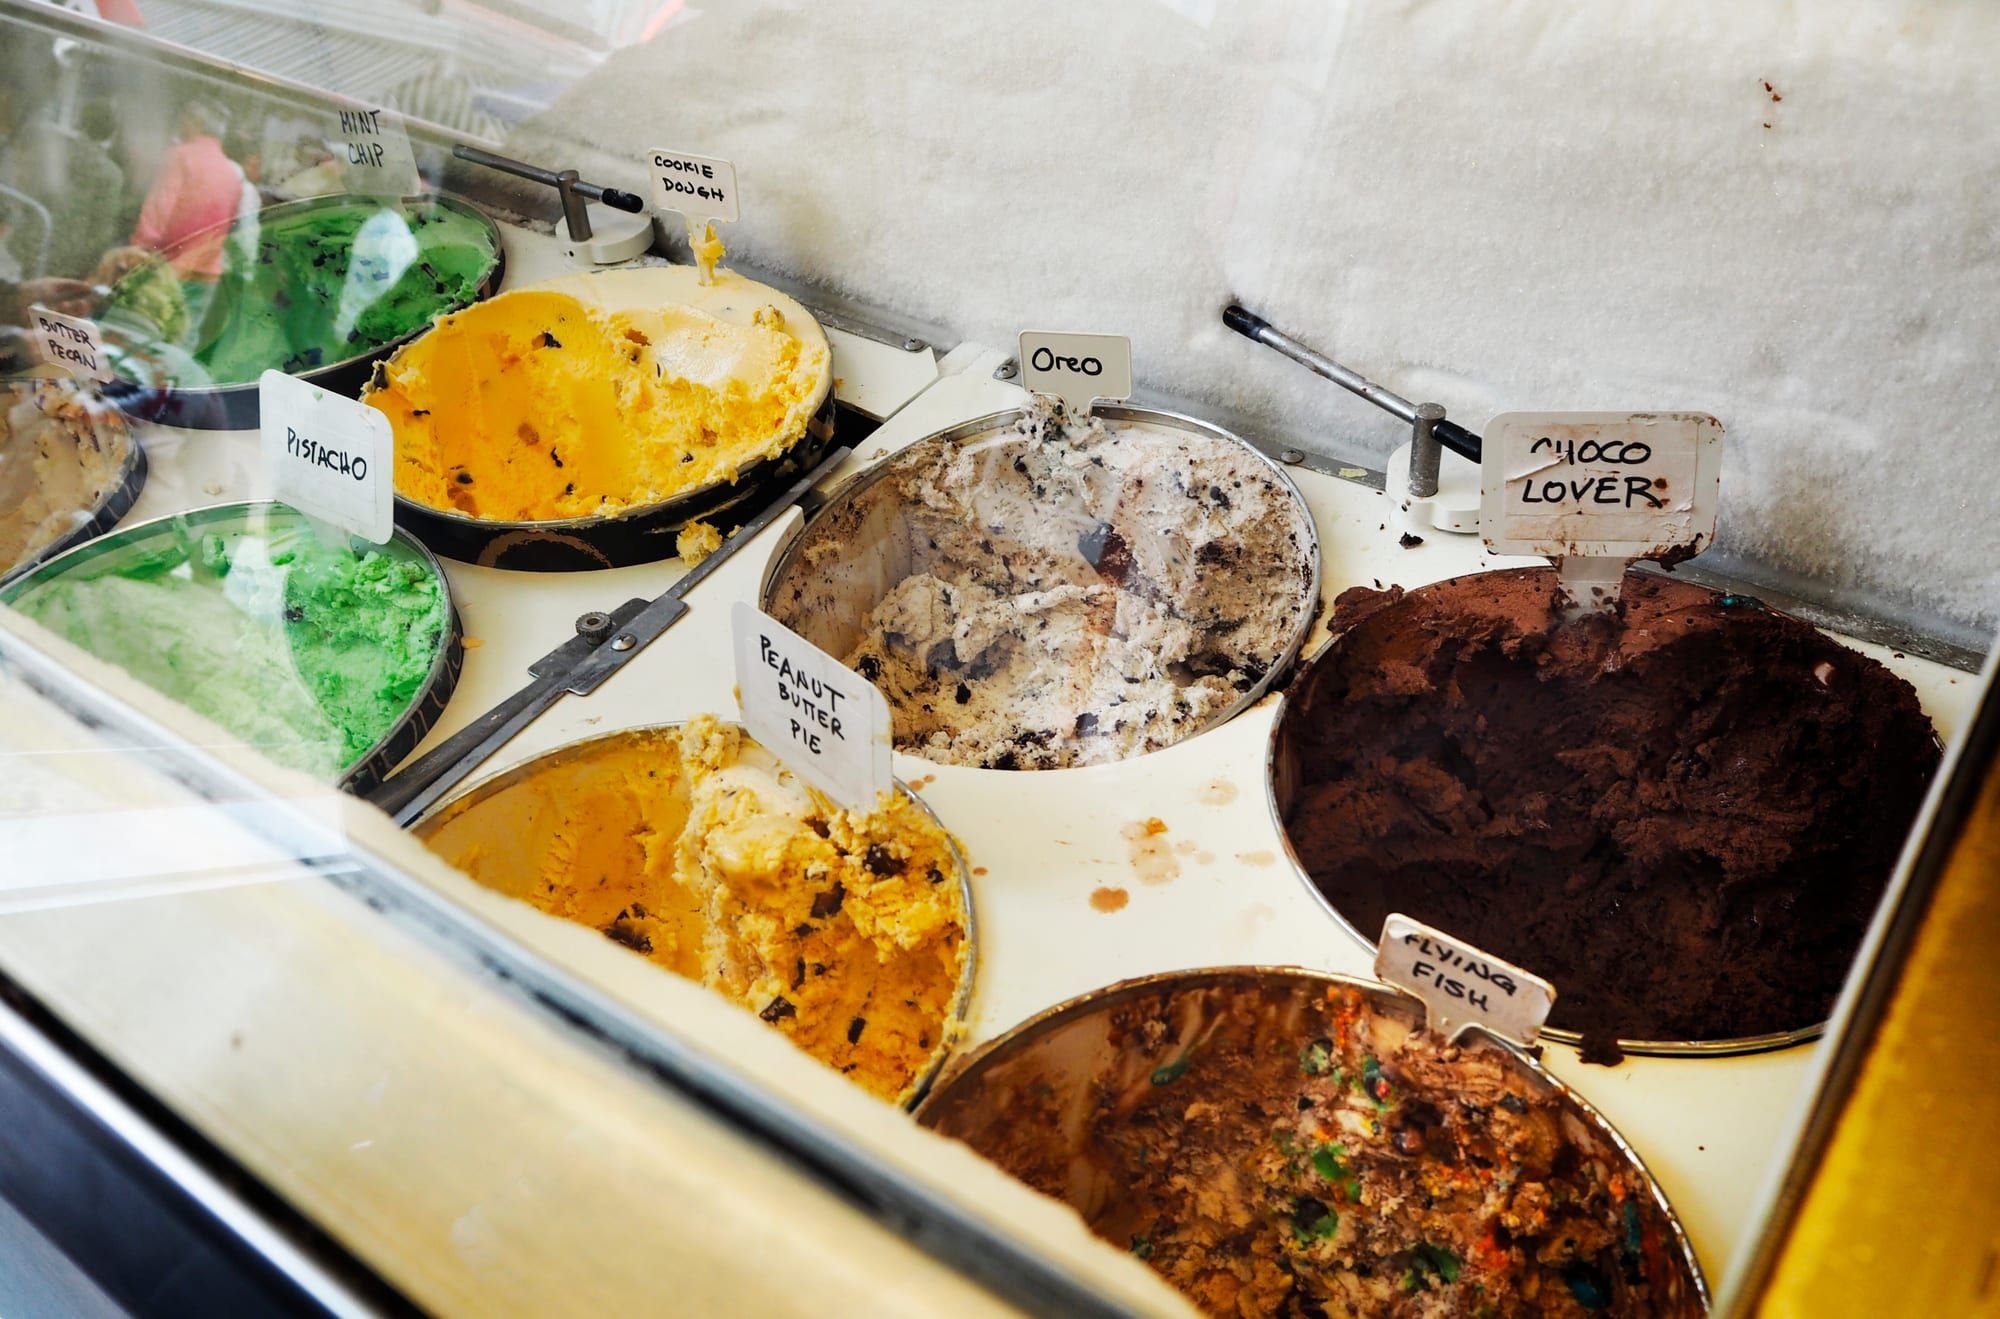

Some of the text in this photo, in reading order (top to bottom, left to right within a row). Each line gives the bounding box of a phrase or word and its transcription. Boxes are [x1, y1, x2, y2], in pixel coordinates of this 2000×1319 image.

[339, 110, 380, 135] MINT
[348, 142, 384, 168] CHIP
[654, 155, 714, 179] COOKIE
[662, 177, 724, 202] DOUGH
[39, 317, 97, 351] BUTTER
[47, 339, 97, 371] PECAN
[1031, 347, 1103, 376] Oreo
[287, 426, 367, 481] PISTACHO
[1521, 476, 1664, 509] LOVER
[759, 634, 846, 712] PEANUT
[778, 681, 845, 741] BUTTER
[790, 718, 822, 754] PIE
[1404, 934, 1518, 997] FLYING
[1412, 960, 1489, 1013] FISH
